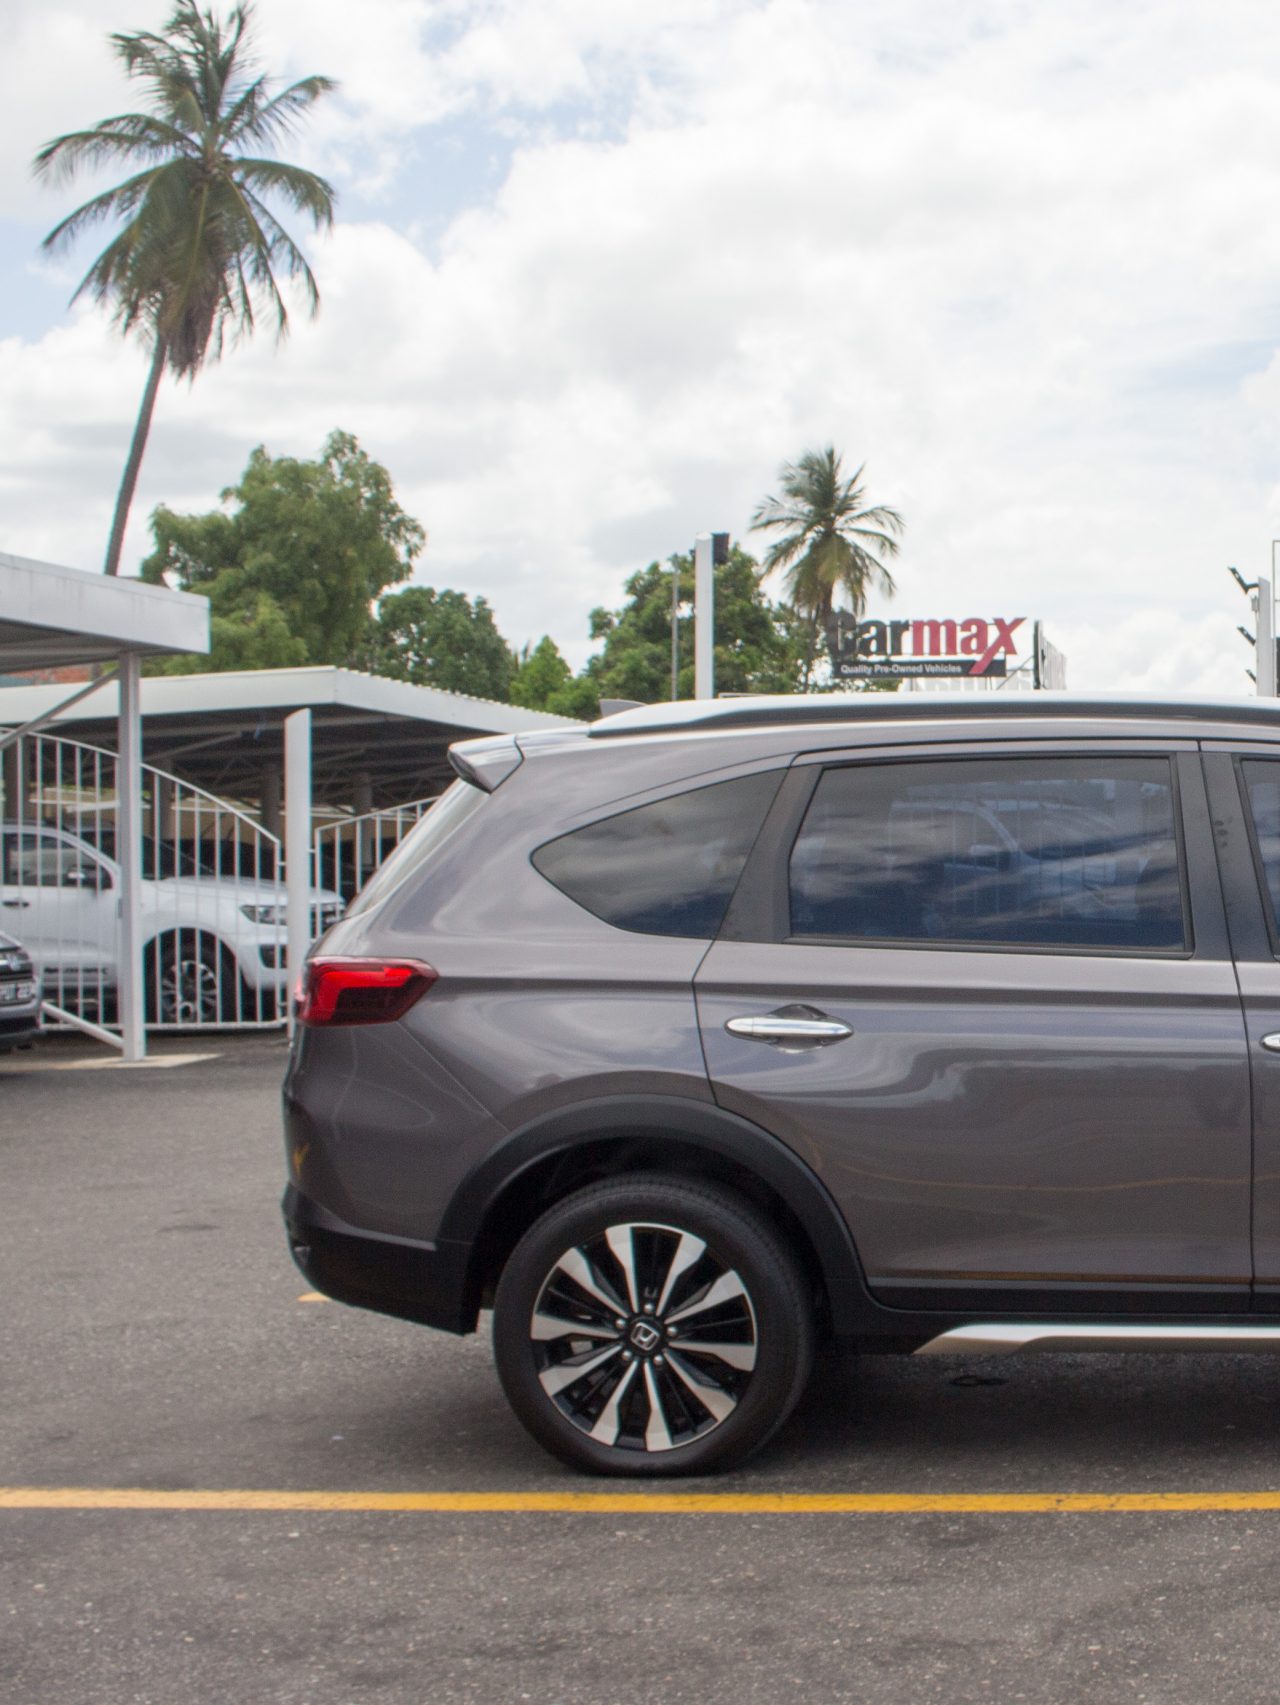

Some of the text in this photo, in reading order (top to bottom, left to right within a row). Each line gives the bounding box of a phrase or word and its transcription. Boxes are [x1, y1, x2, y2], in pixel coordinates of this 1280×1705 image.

[840, 664, 962, 676] Quality Pre-Owned Vehicles
